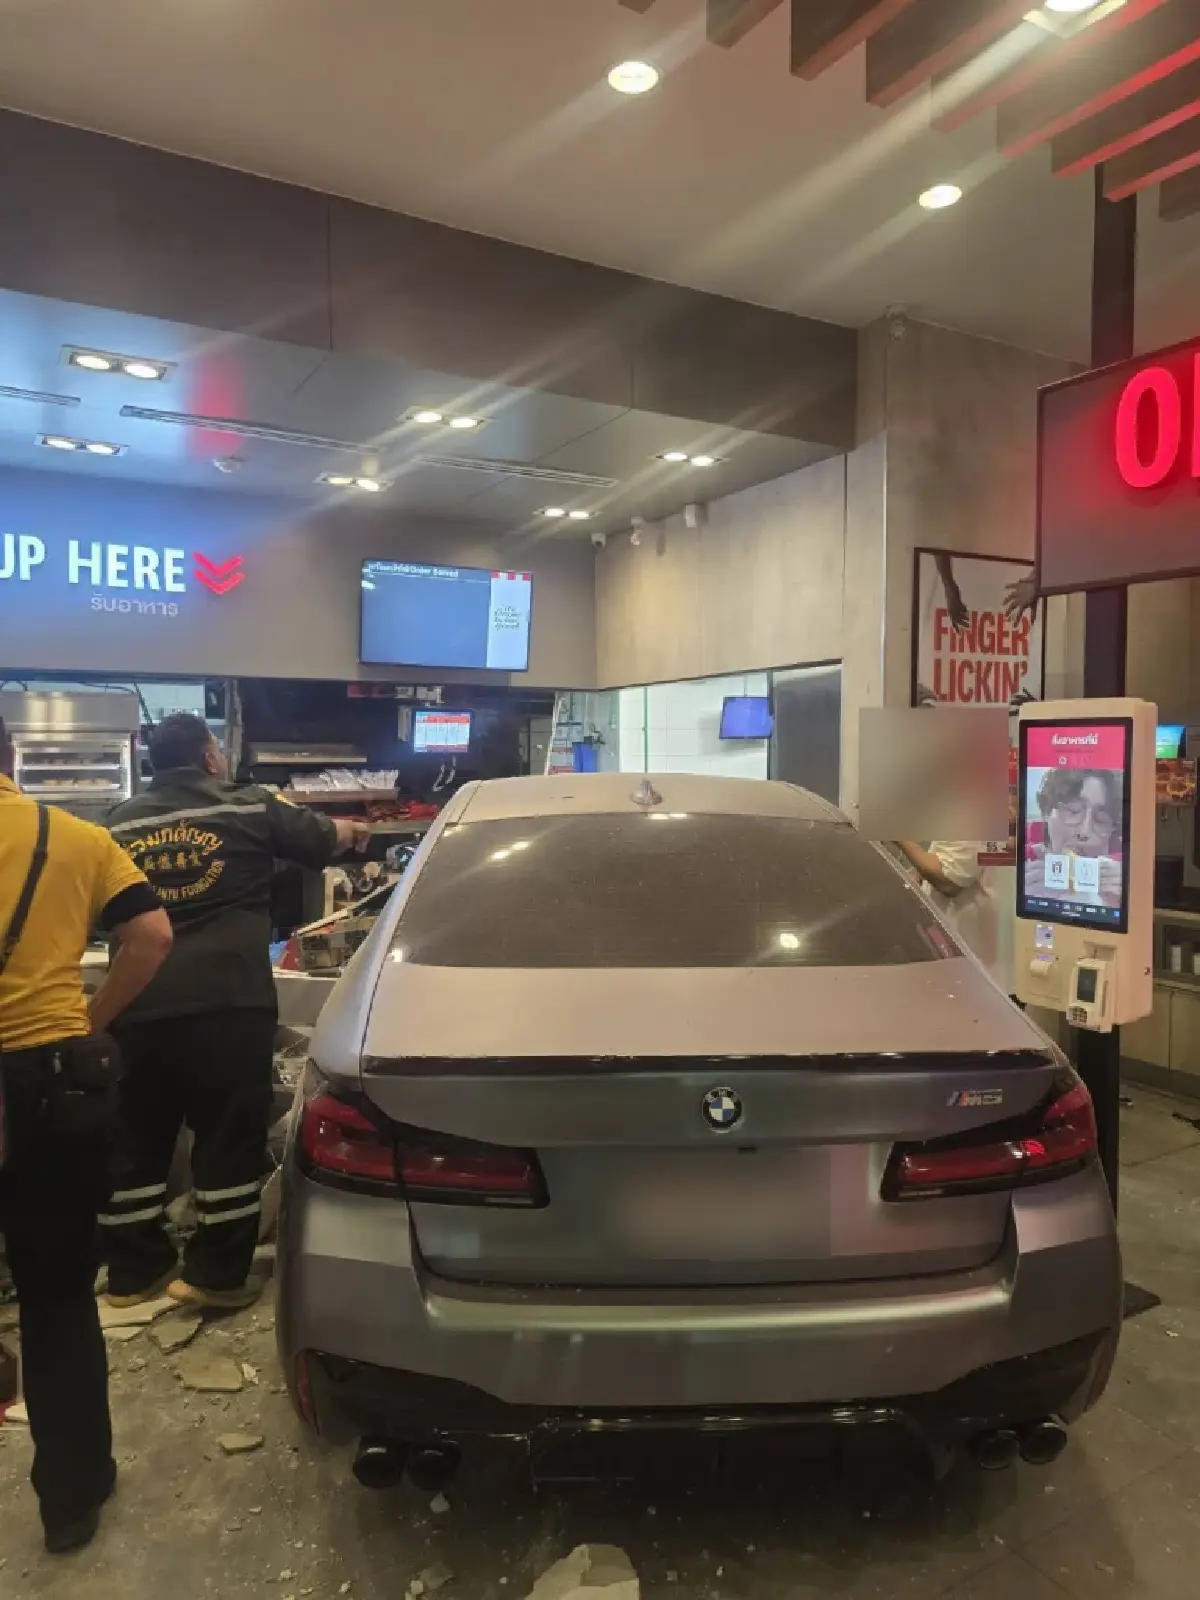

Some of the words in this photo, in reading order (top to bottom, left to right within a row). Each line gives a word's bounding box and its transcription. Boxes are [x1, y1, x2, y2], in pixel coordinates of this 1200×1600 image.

[1116, 352, 1200, 488] O
[68, 539, 187, 592] HERE
[90, 592, 179, 617] รับอาหาร
[933, 657, 1028, 704] LICKIN'
